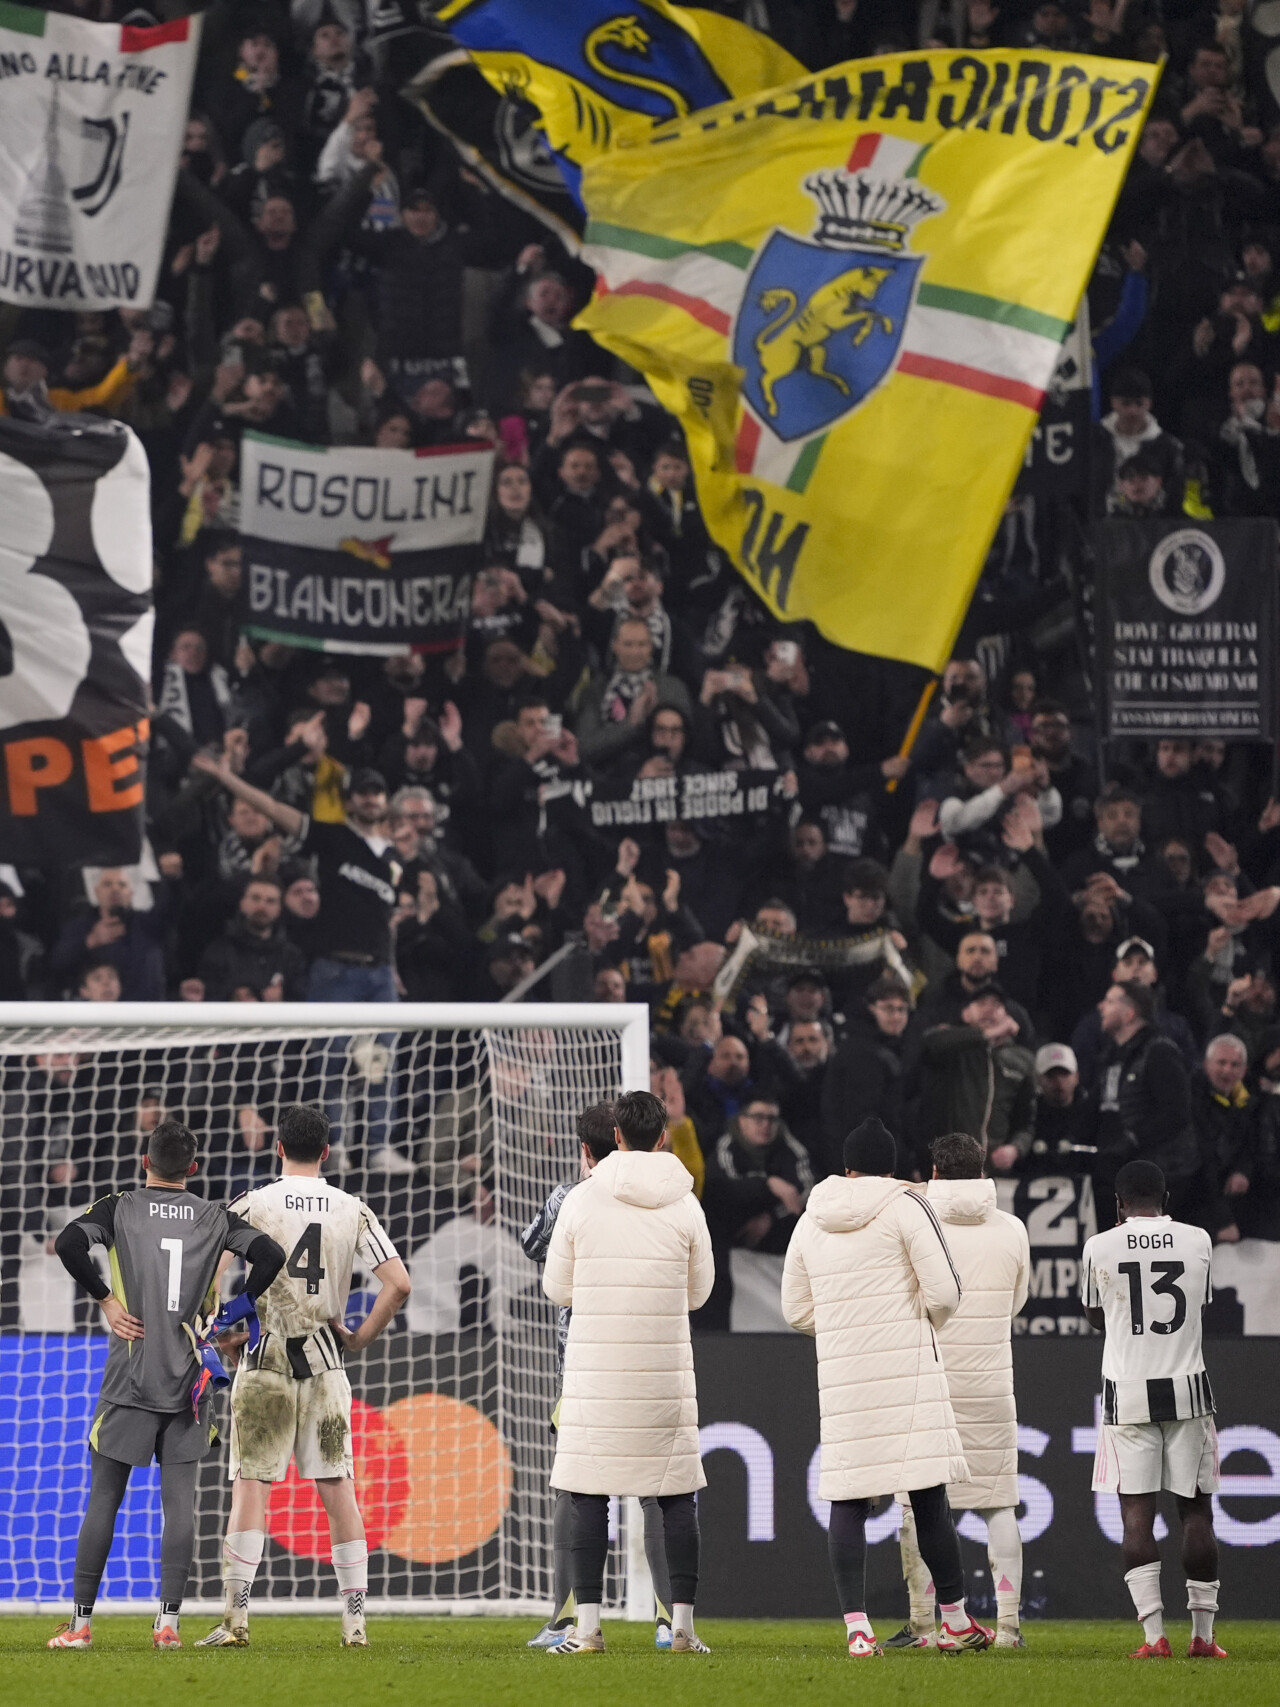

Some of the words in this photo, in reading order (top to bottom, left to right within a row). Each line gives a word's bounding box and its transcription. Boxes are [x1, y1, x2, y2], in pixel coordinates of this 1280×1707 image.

[44, 53, 111, 86] ALLA
[257, 461, 476, 521] ROSOLINI
[249, 563, 471, 628] BIANCONERA
[149, 1202, 195, 1221] PERIN
[285, 1194, 330, 1212] GATTI
[286, 1222, 325, 1295] 4
[1127, 1233, 1174, 1250] BOGA
[160, 1237, 184, 1312] 1
[1118, 1260, 1186, 1335] 13
